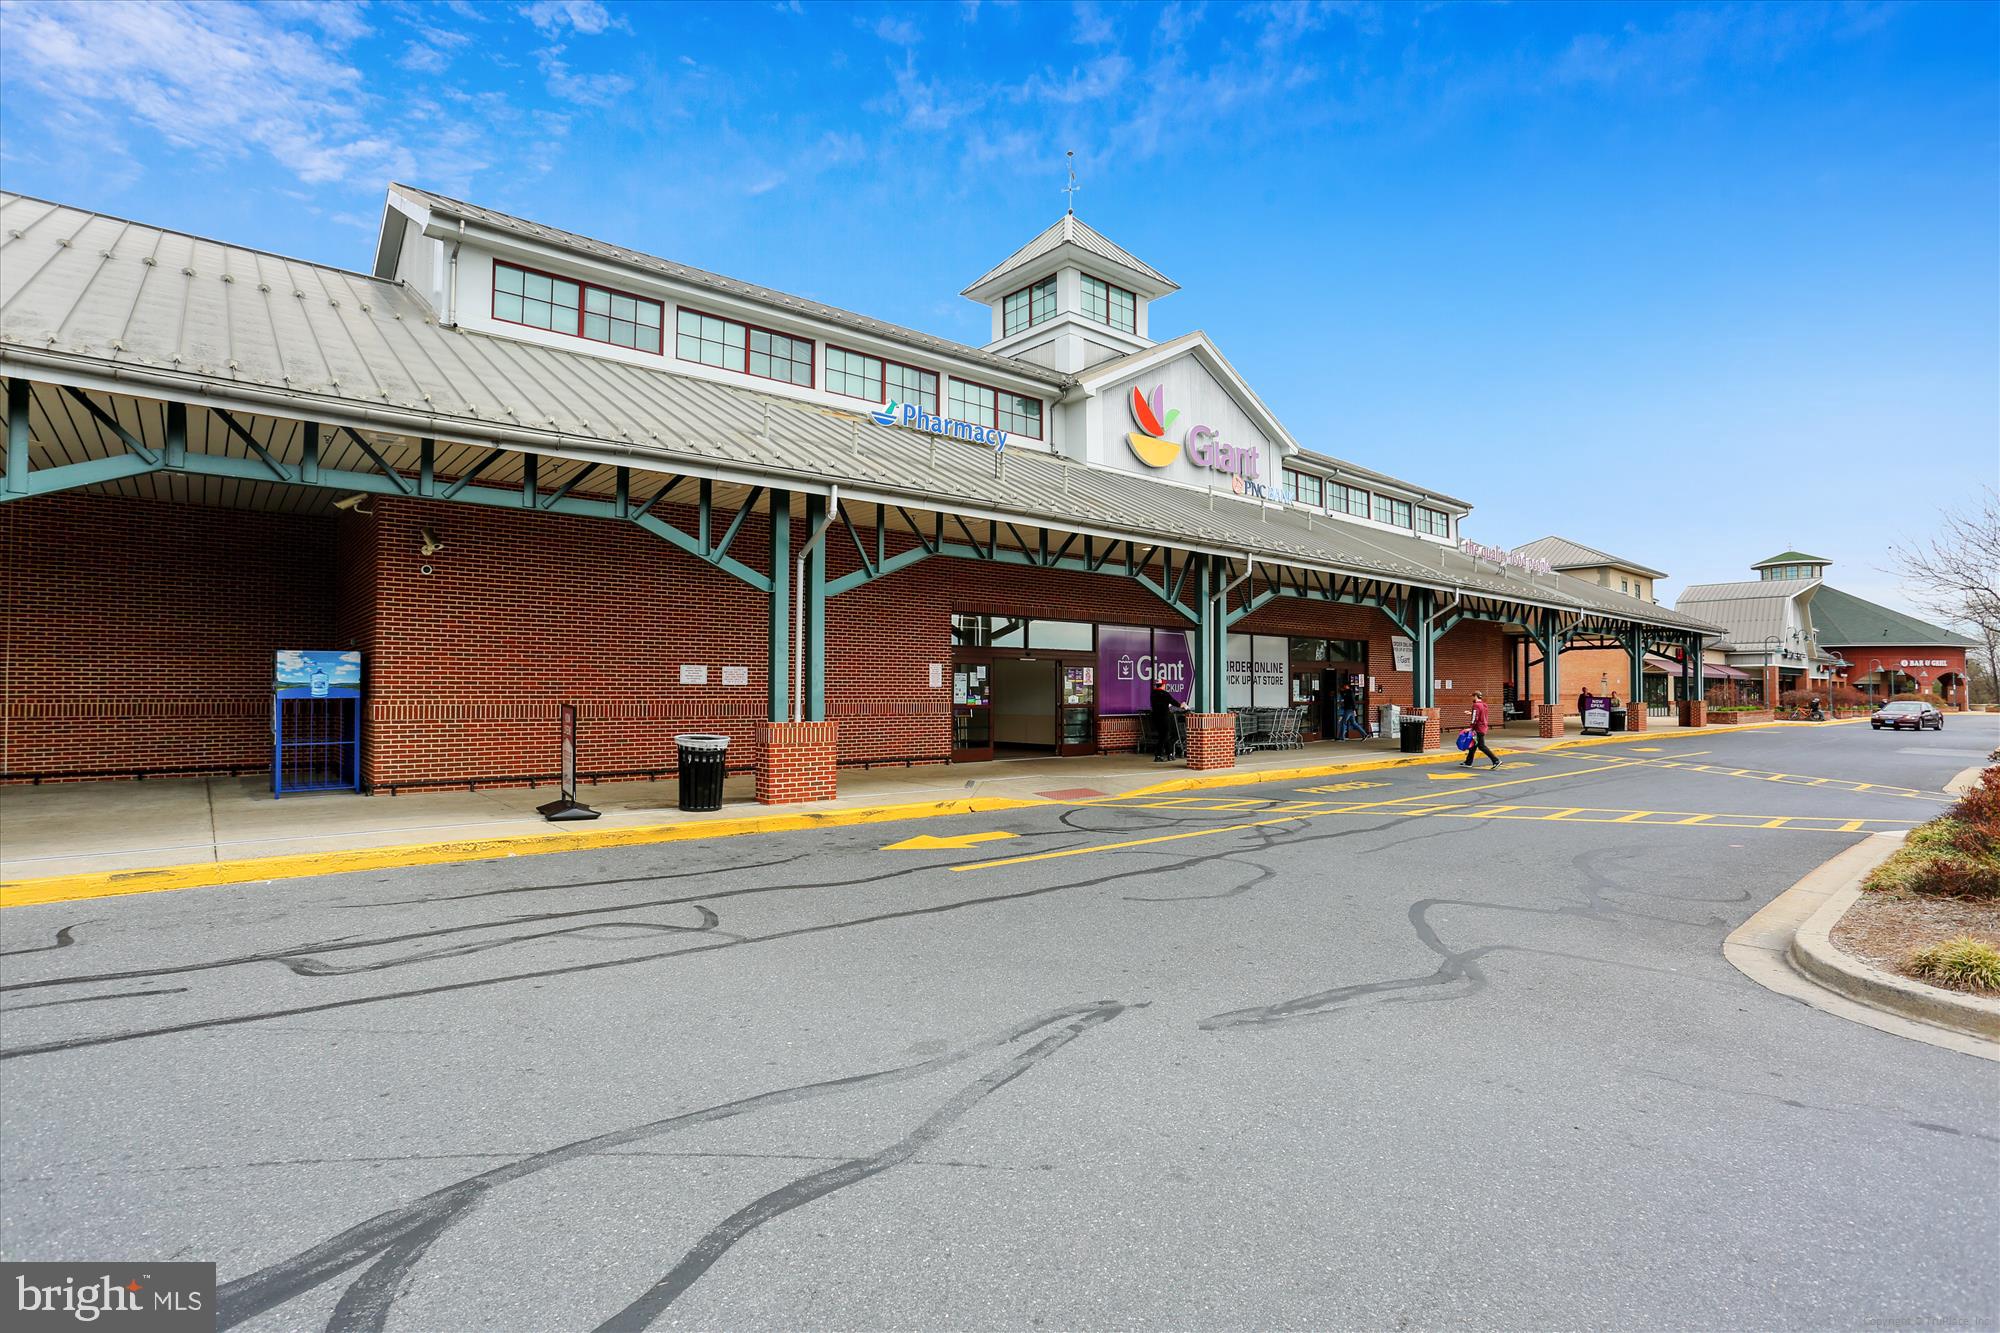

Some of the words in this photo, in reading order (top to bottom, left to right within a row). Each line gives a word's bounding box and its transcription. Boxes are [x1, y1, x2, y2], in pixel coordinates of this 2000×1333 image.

[902, 402, 1008, 453] Pharmacy
[1185, 424, 1260, 480] Giant
[1244, 479, 1266, 500] PNC
[1465, 538, 1479, 556] the
[1136, 654, 1184, 681] Giant
[1254, 661, 1283, 674] ONLINE
[1241, 675, 1251, 685] UP
[1252, 675, 1262, 686] AT
[1262, 675, 1283, 686] STORE
